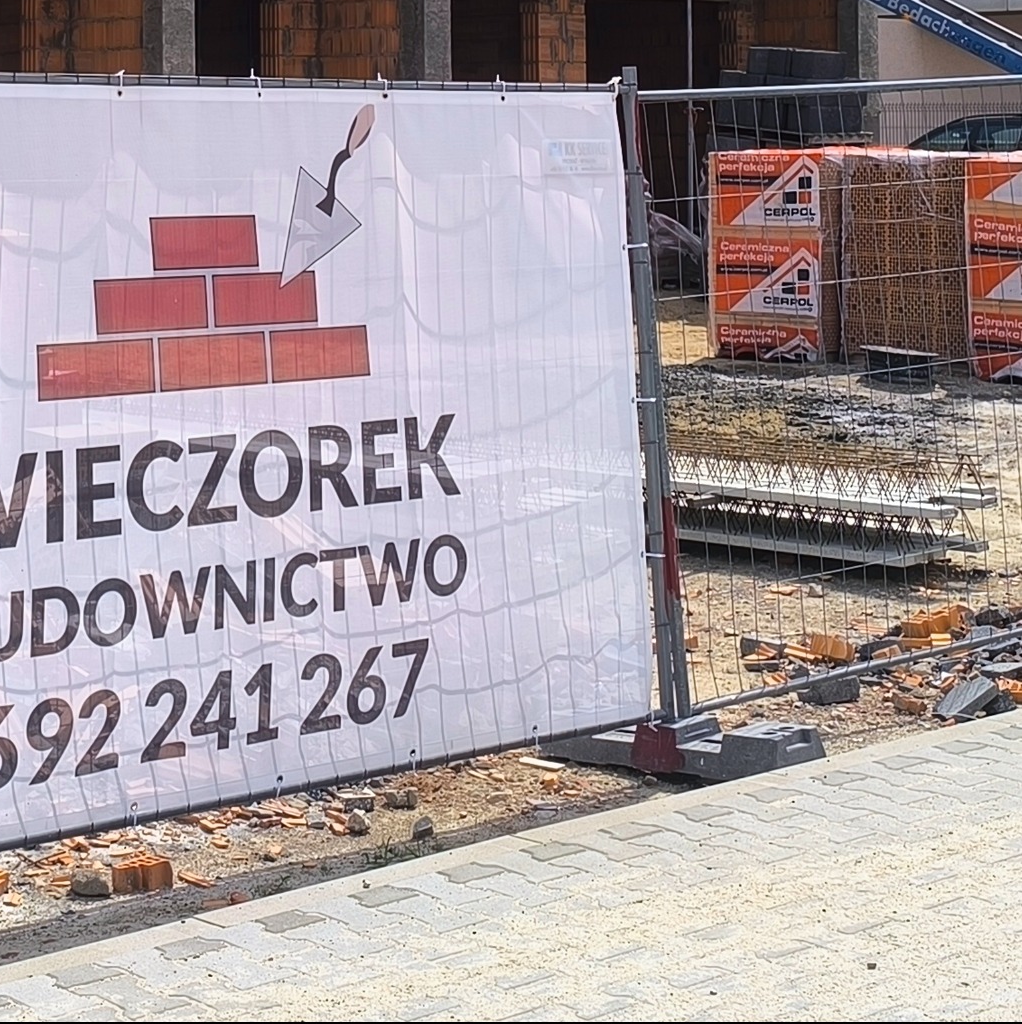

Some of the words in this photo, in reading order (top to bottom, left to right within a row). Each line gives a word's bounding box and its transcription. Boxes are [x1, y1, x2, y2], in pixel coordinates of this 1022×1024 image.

[719, 162, 775, 173] perfekcja
[764, 207, 816, 217] CERPOL
[720, 241, 790, 253] Ceramiczna
[720, 252, 775, 264] perfekcja
[763, 296, 814, 307] CERPOL
[140, 663, 280, 764] 241
[299, 638, 430, 736] 267
